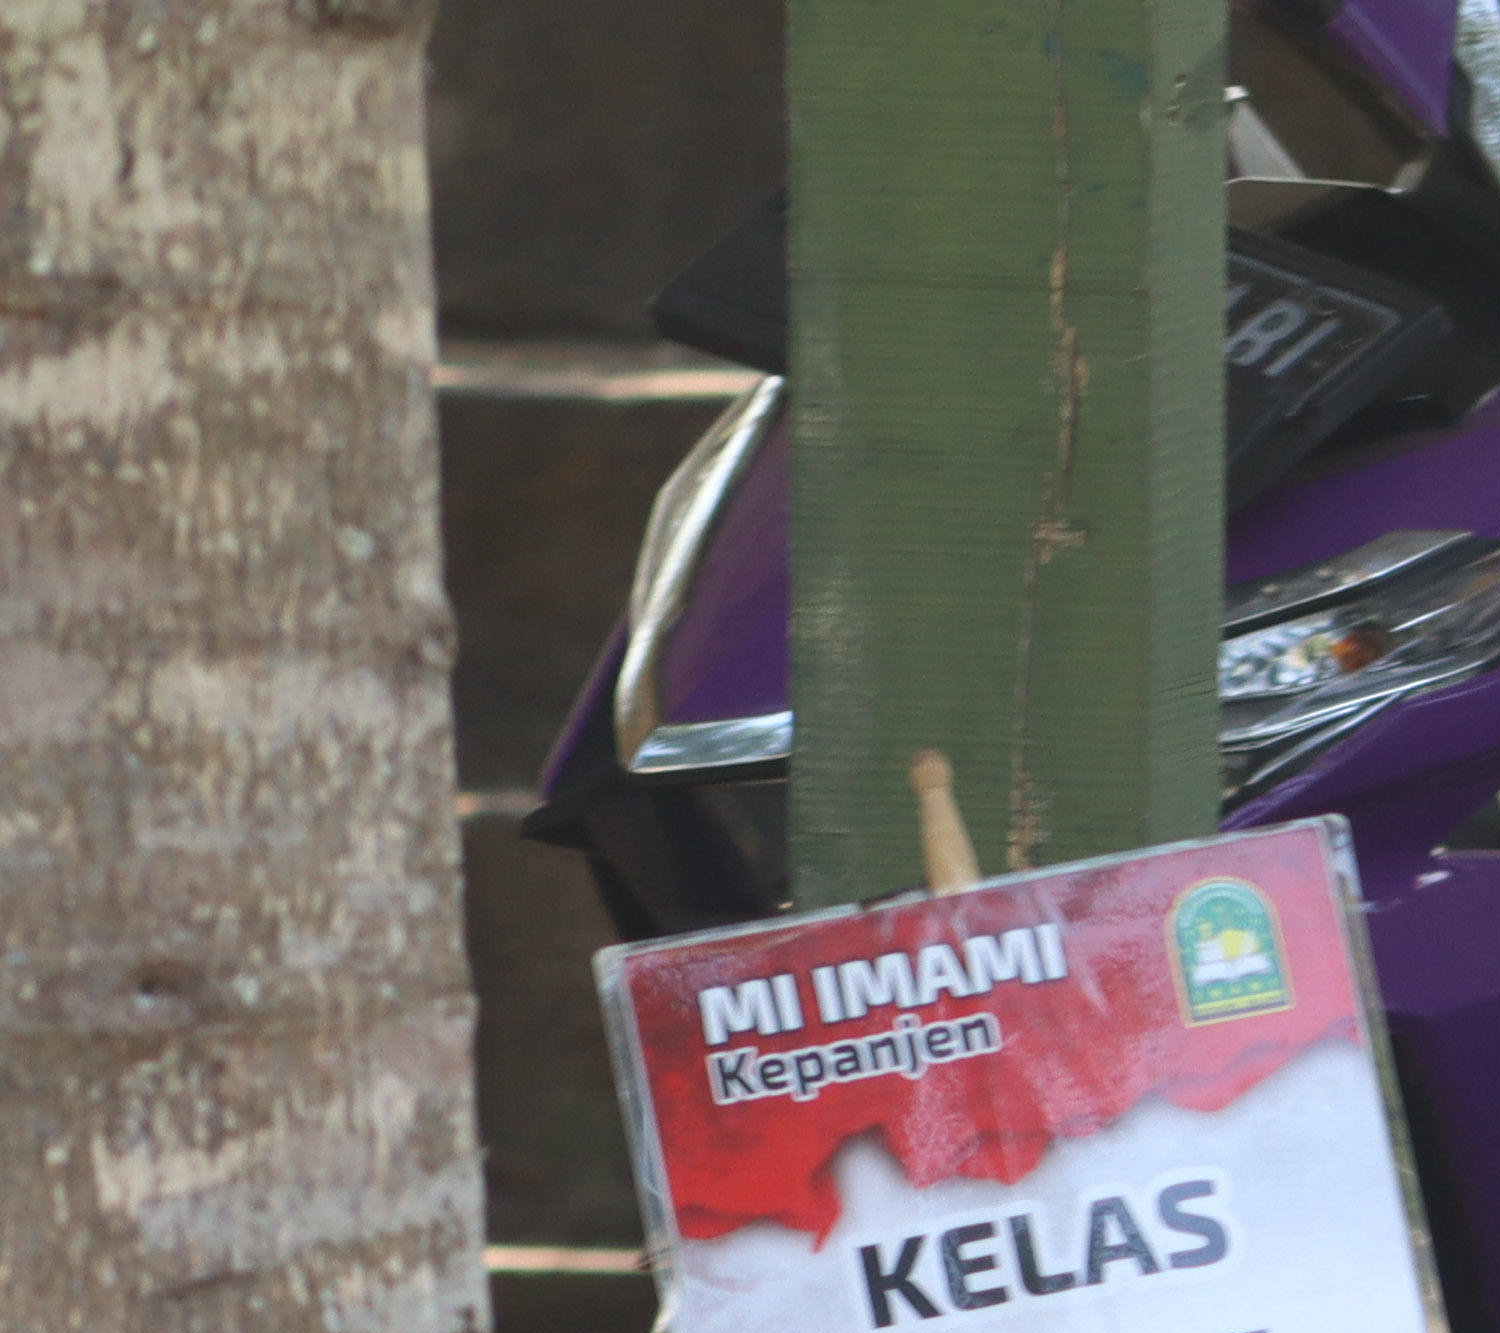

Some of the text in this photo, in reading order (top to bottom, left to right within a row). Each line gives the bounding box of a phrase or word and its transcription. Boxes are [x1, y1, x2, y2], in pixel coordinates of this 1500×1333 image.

[698, 922, 1069, 1046] MI IMAMI
[709, 1014, 1000, 1102] Kepanjen
[858, 1179, 1229, 1330] KELAS
